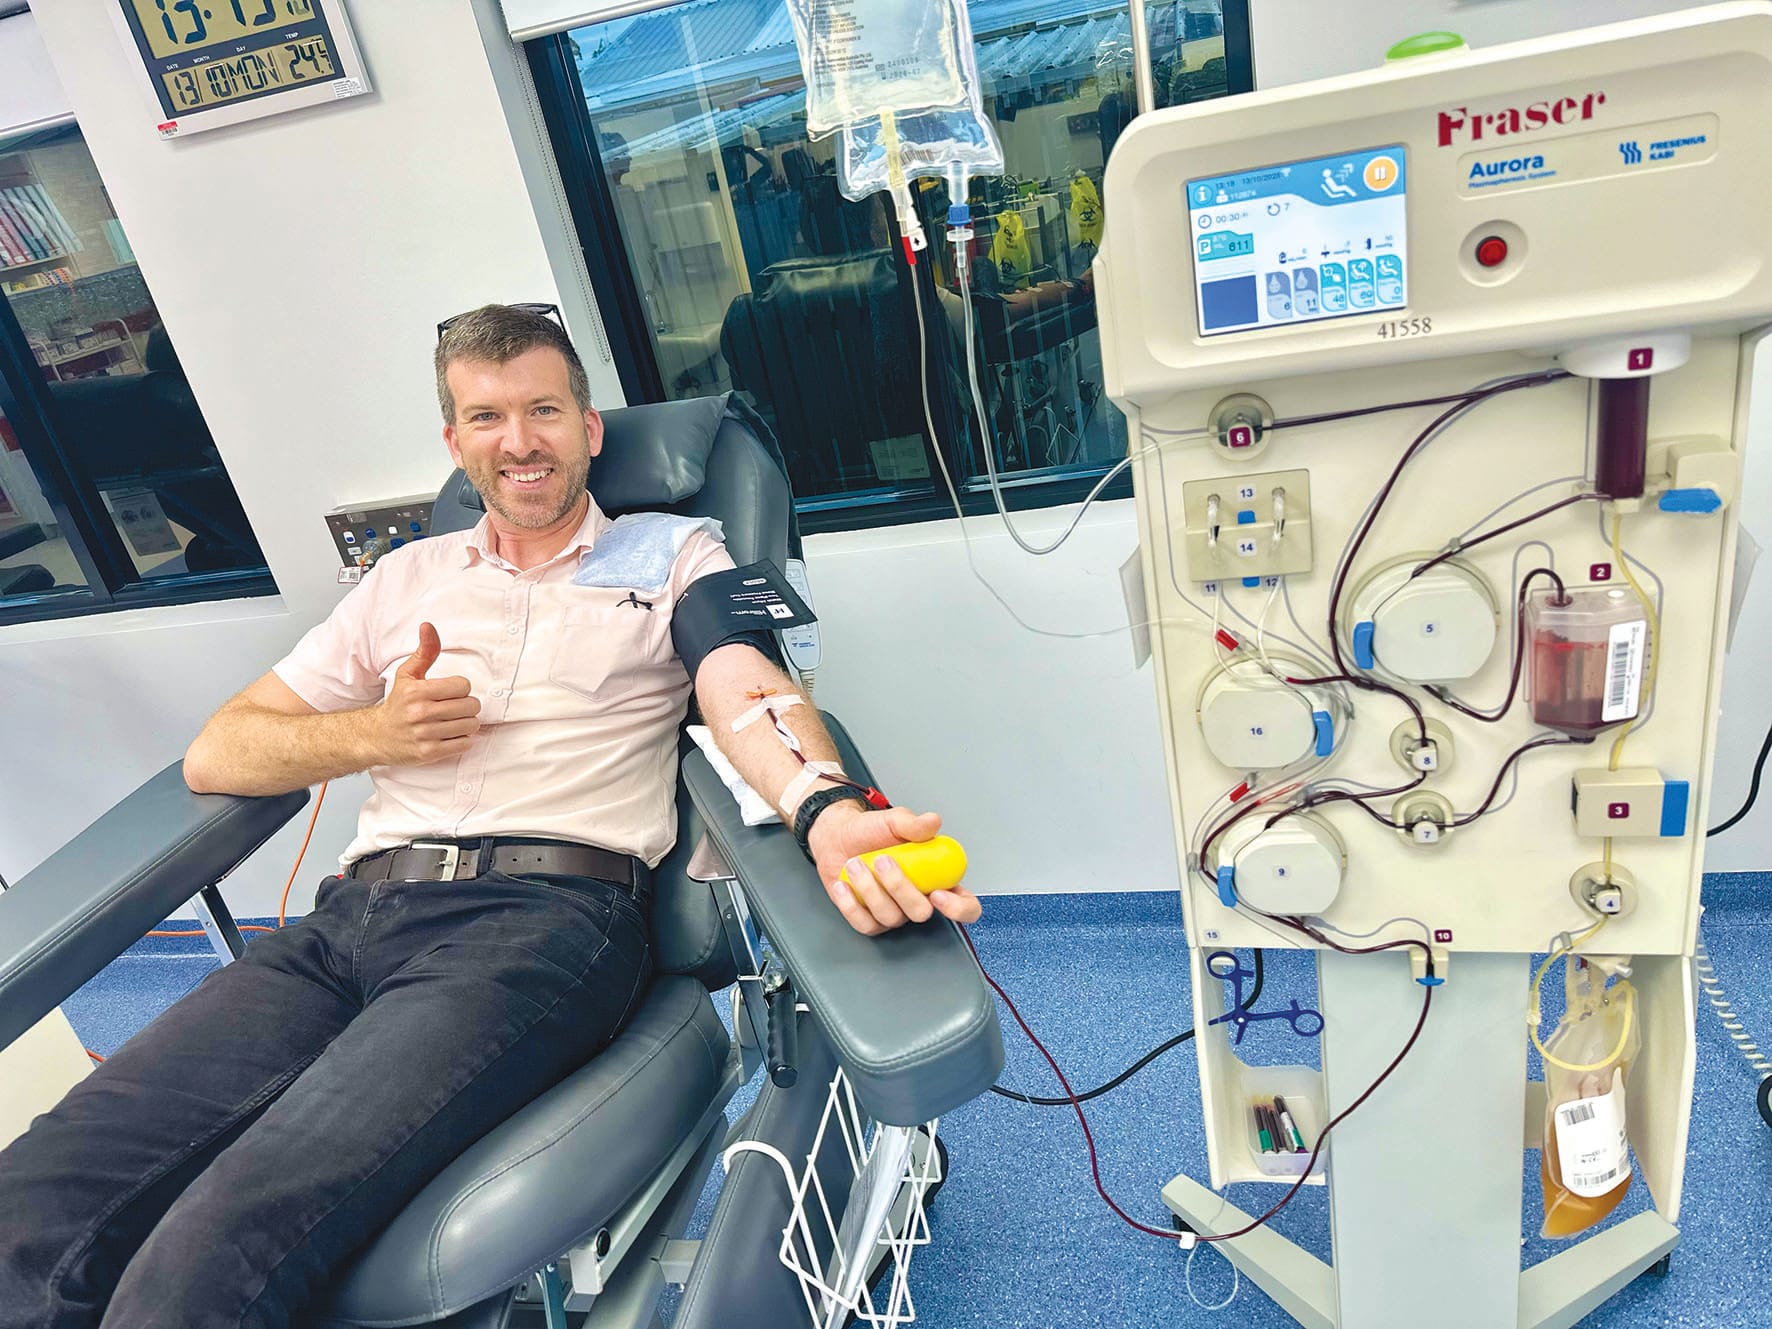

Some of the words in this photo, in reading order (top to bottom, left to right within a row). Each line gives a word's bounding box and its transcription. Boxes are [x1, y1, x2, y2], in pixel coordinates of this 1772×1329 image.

[236, 45, 246, 53] DAY
[192, 55, 210, 64] MONTH
[166, 63, 179, 71] DATE
[226, 54, 280, 94] MON
[174, 71, 200, 105] 13
[1437, 91, 1606, 148] Fraser
[1649, 134, 1706, 151] FRESENIUS
[1649, 149, 1675, 160] KABI
[1469, 154, 1545, 179] Aurora
[1377, 317, 1432, 339] 41558
[1636, 353, 1645, 365] 1
[1236, 432, 1244, 443] 6
[1240, 488, 1254, 498] 13
[1240, 543, 1254, 553] 14
[1596, 567, 1605, 578] 2
[1265, 577, 1278, 587] 12
[1205, 583, 1217, 593] 11
[1426, 623, 1434, 633] 5
[1250, 727, 1263, 737] 16
[1424, 756, 1431, 765] 8
[1615, 806, 1623, 815] 3
[1424, 831, 1431, 839] 7
[1278, 868, 1286, 877] 9
[1607, 900, 1614, 908] 4
[1207, 931, 1218, 939] 15
[1437, 932, 1450, 941] 10
